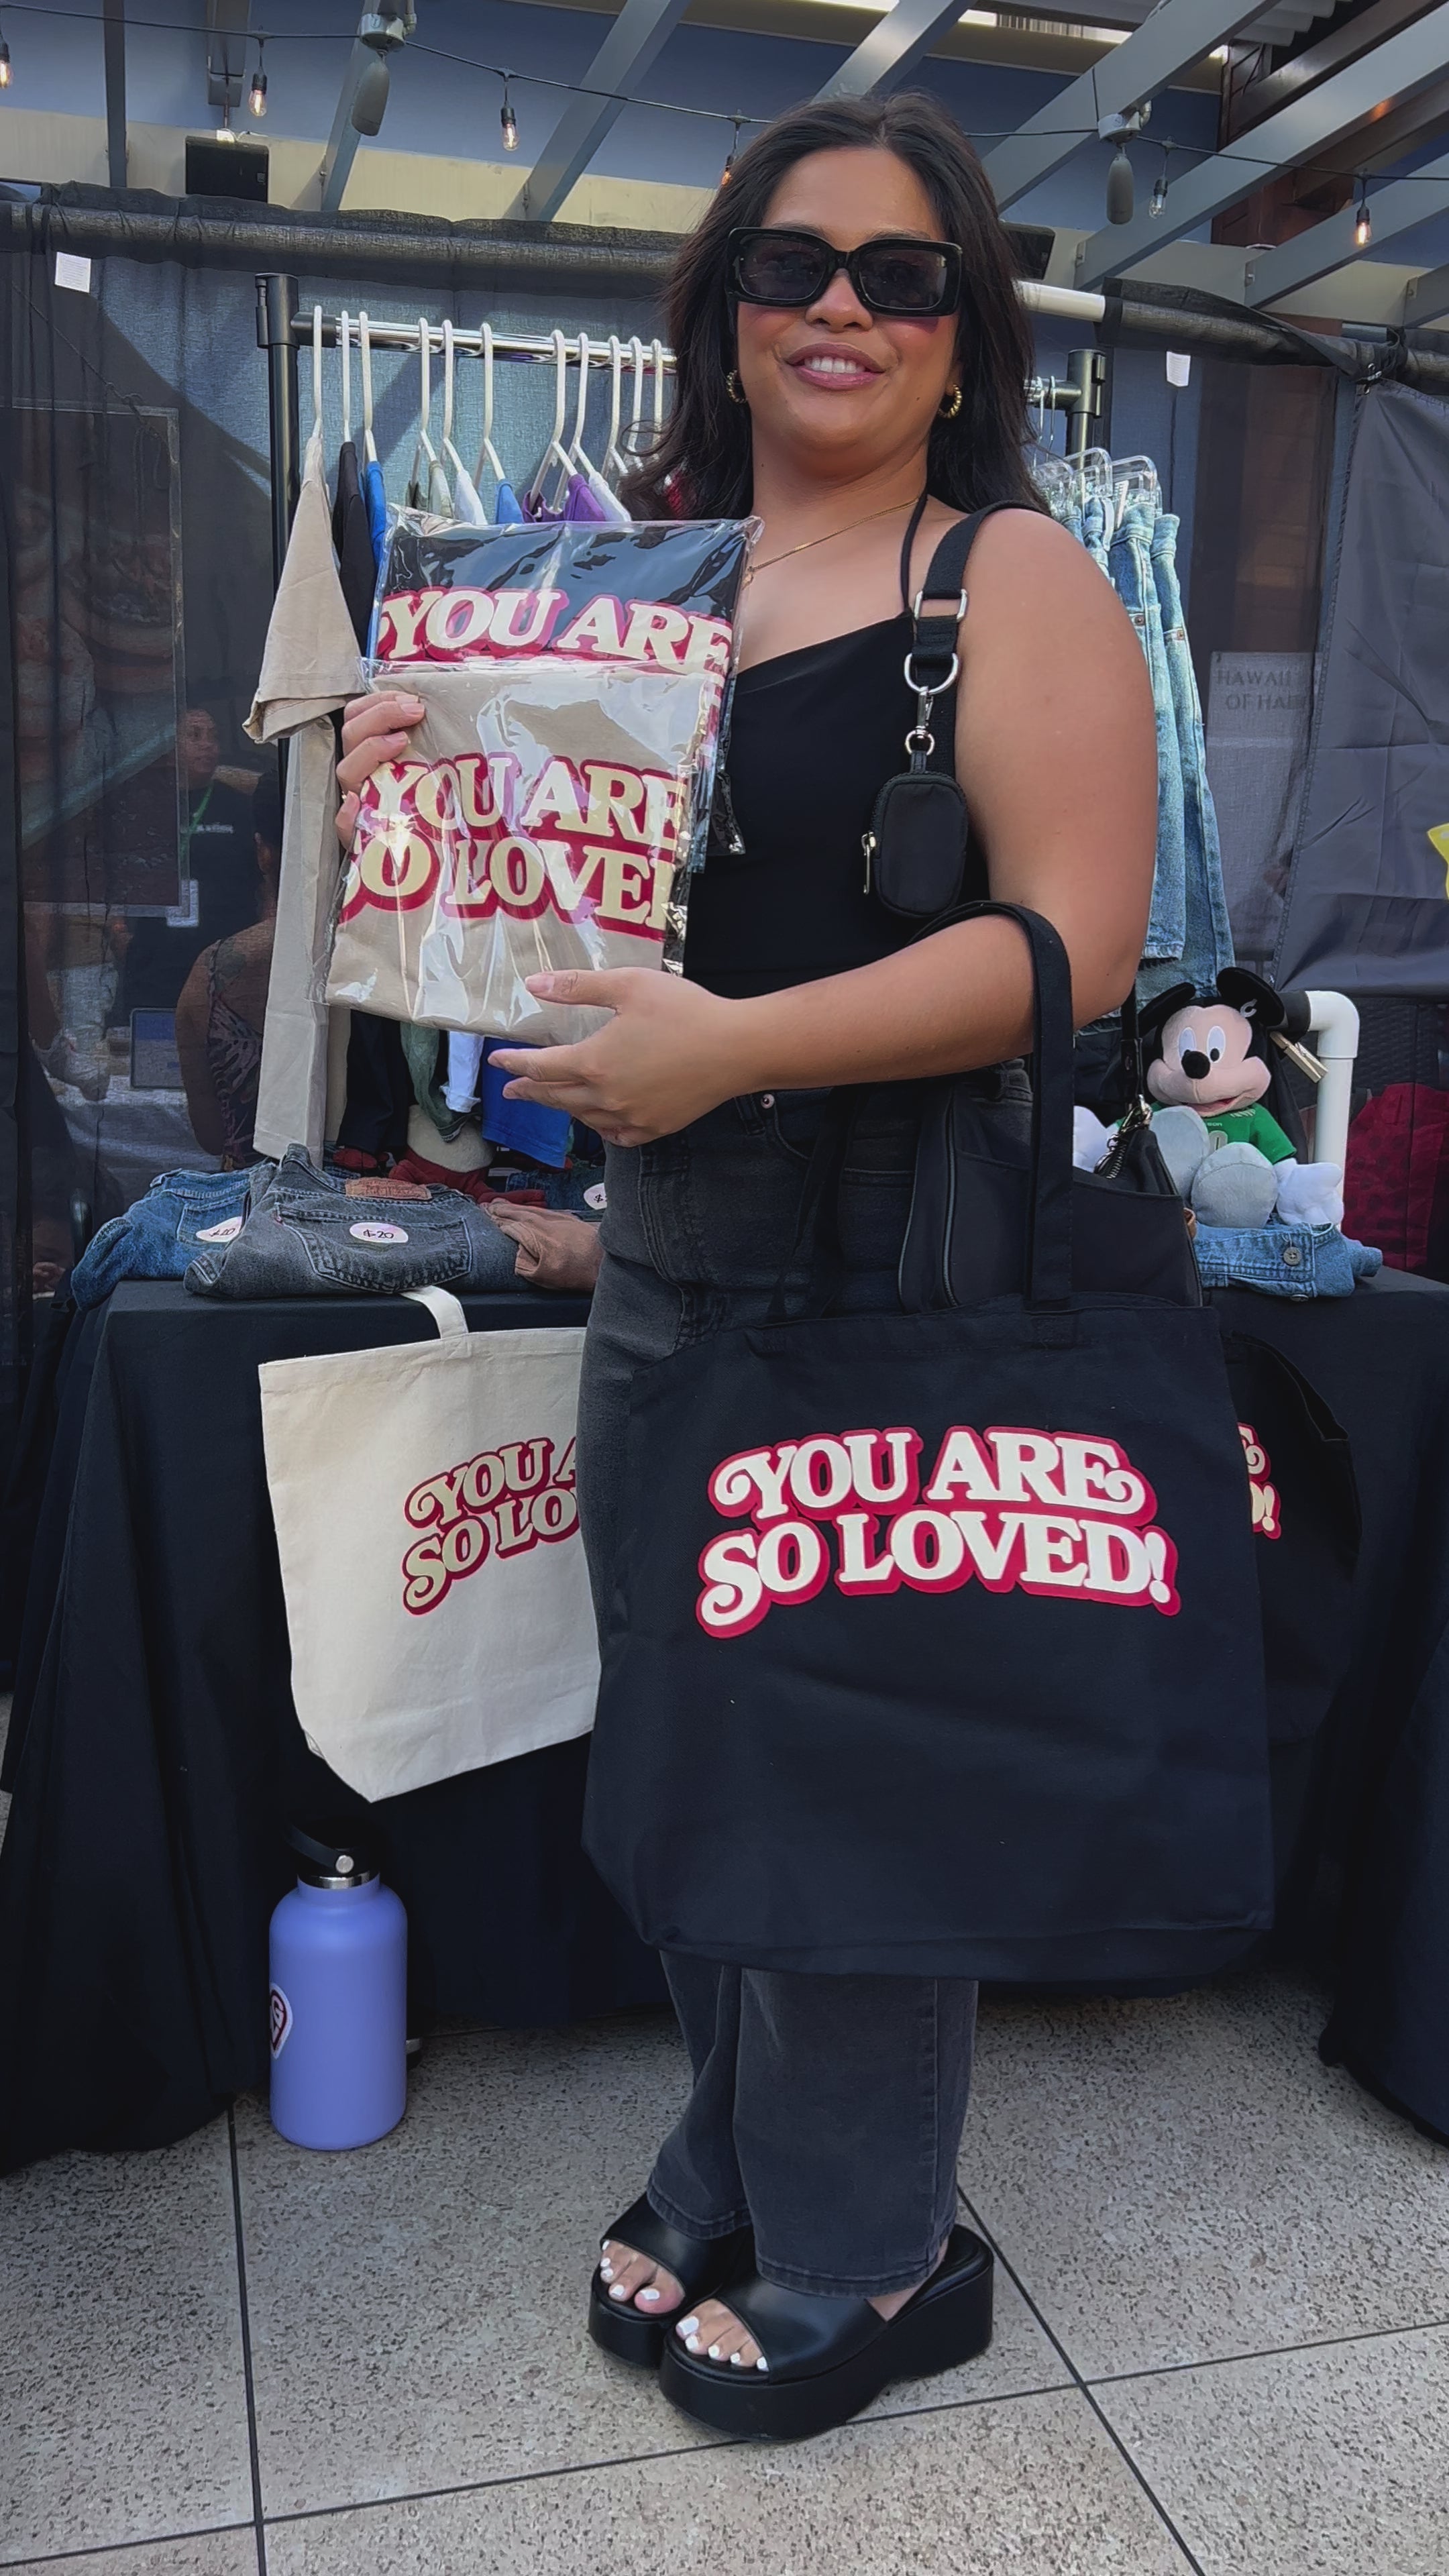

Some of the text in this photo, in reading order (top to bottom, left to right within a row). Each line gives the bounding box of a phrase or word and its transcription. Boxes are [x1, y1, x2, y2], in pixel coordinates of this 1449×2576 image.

[378, 589, 562, 659] YOU
[1225, 693, 1250, 710] OF
[360, 756, 514, 828] YOU
[362, 1228, 394, 1239] $20
[409, 1440, 549, 1525] YOU
[713, 1432, 914, 1519] YOU
[927, 1429, 1147, 1516] ARE
[405, 1517, 485, 1609] SO
[700, 1509, 1171, 1627] SO LOVED!
